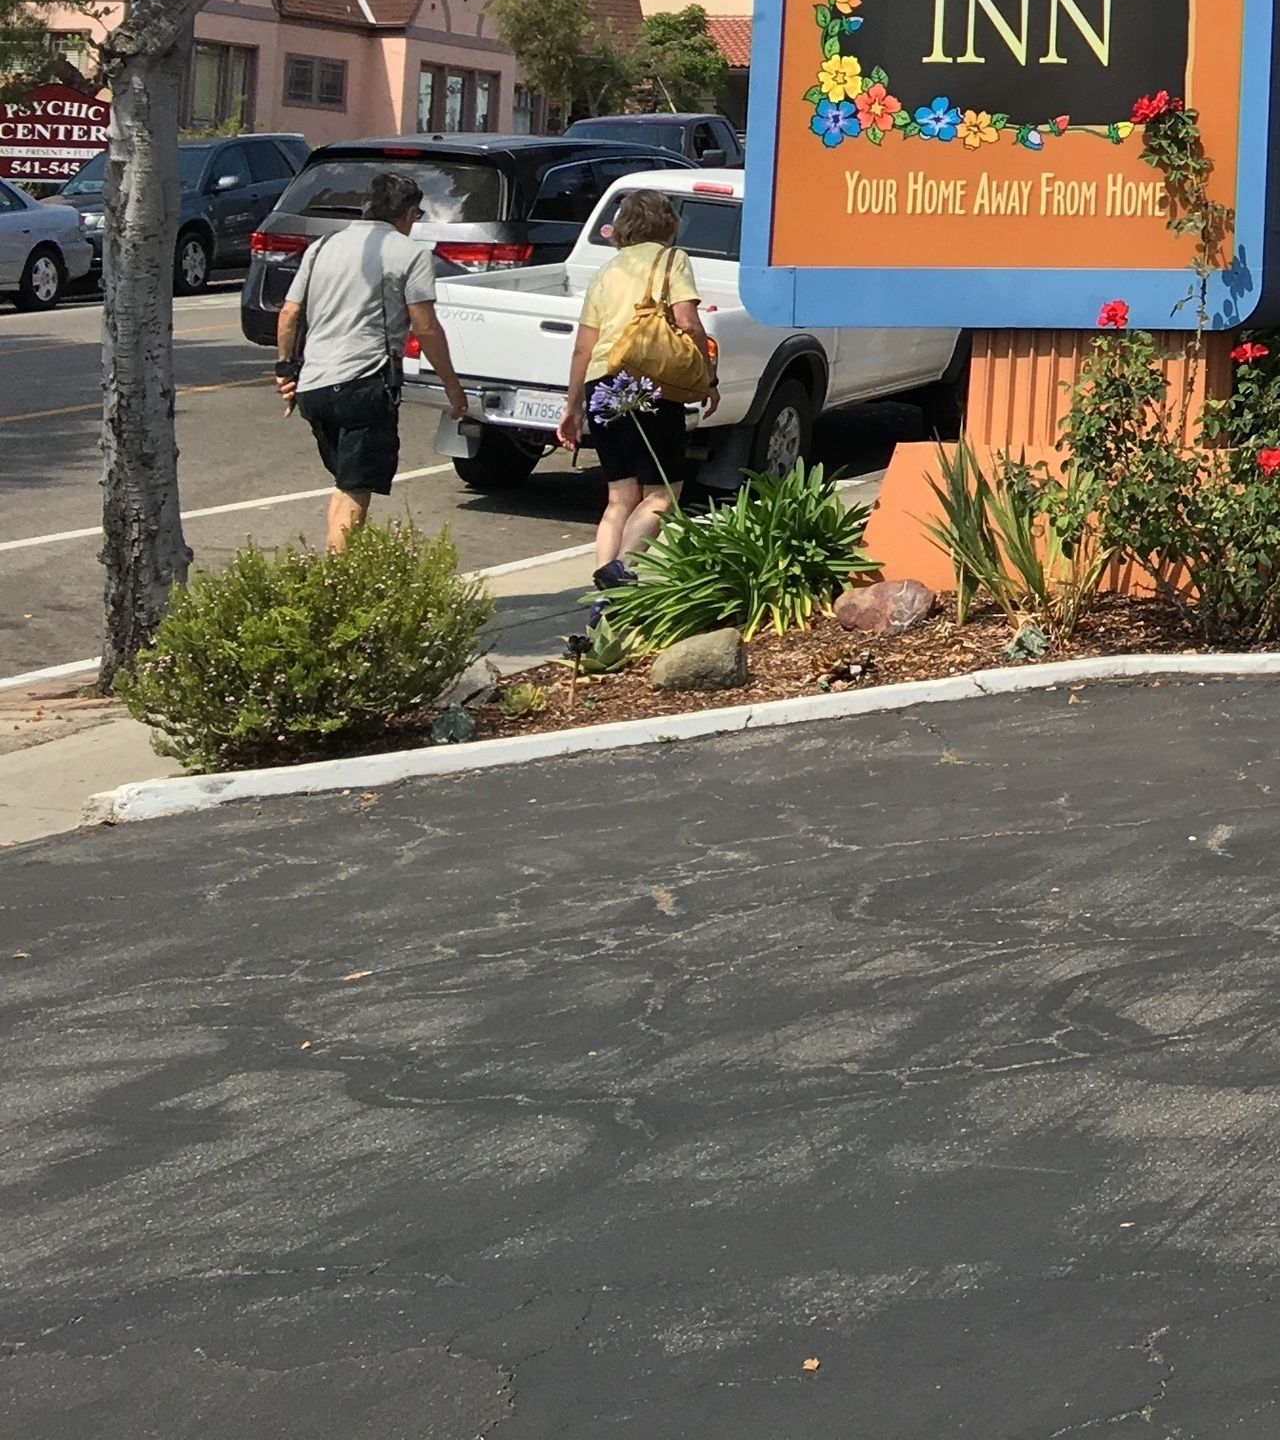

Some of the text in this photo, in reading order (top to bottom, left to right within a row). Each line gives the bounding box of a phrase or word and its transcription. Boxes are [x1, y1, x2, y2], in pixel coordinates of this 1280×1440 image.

[4, 100, 105, 121] PSYCHIC
[0, 122, 108, 142] CENTER
[10, 160, 81, 176] 541-545
[844, 170, 1167, 218] YOUR HOME AWAY FROM HOME
[439, 309, 486, 324] OYOTA
[520, 401, 567, 420] 7N7856
